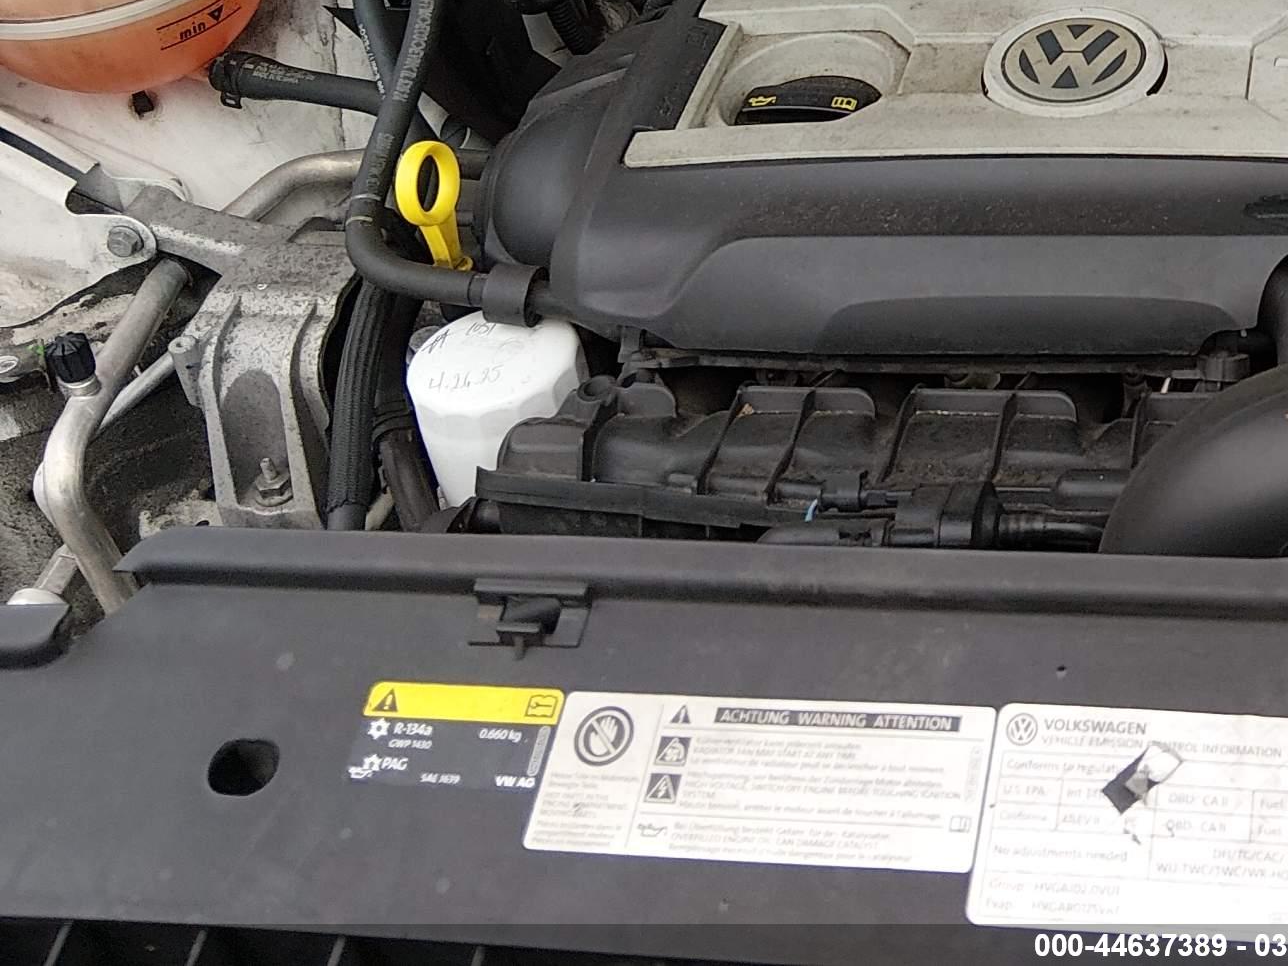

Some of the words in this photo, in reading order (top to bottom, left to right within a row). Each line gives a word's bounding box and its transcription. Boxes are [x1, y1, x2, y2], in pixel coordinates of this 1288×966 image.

[179, 21, 207, 41] min
[720, 709, 790, 725] ACHTUNG
[797, 713, 867, 728] WARNING
[873, 715, 953, 731] ATTENTION
[1043, 718, 1148, 736] VOLKSWAGEN
[393, 723, 433, 736] R-134a
[508, 729, 523, 742] kg
[1041, 735, 1086, 747] VEHICLE
[1088, 737, 1144, 750] EMISSION
[1202, 743, 1283, 759] INFORMATION
[382, 757, 408, 771] PAG
[495, 775, 517, 787] VW
[518, 776, 536, 788] AG
[1012, 846, 1082, 861] adjustments
